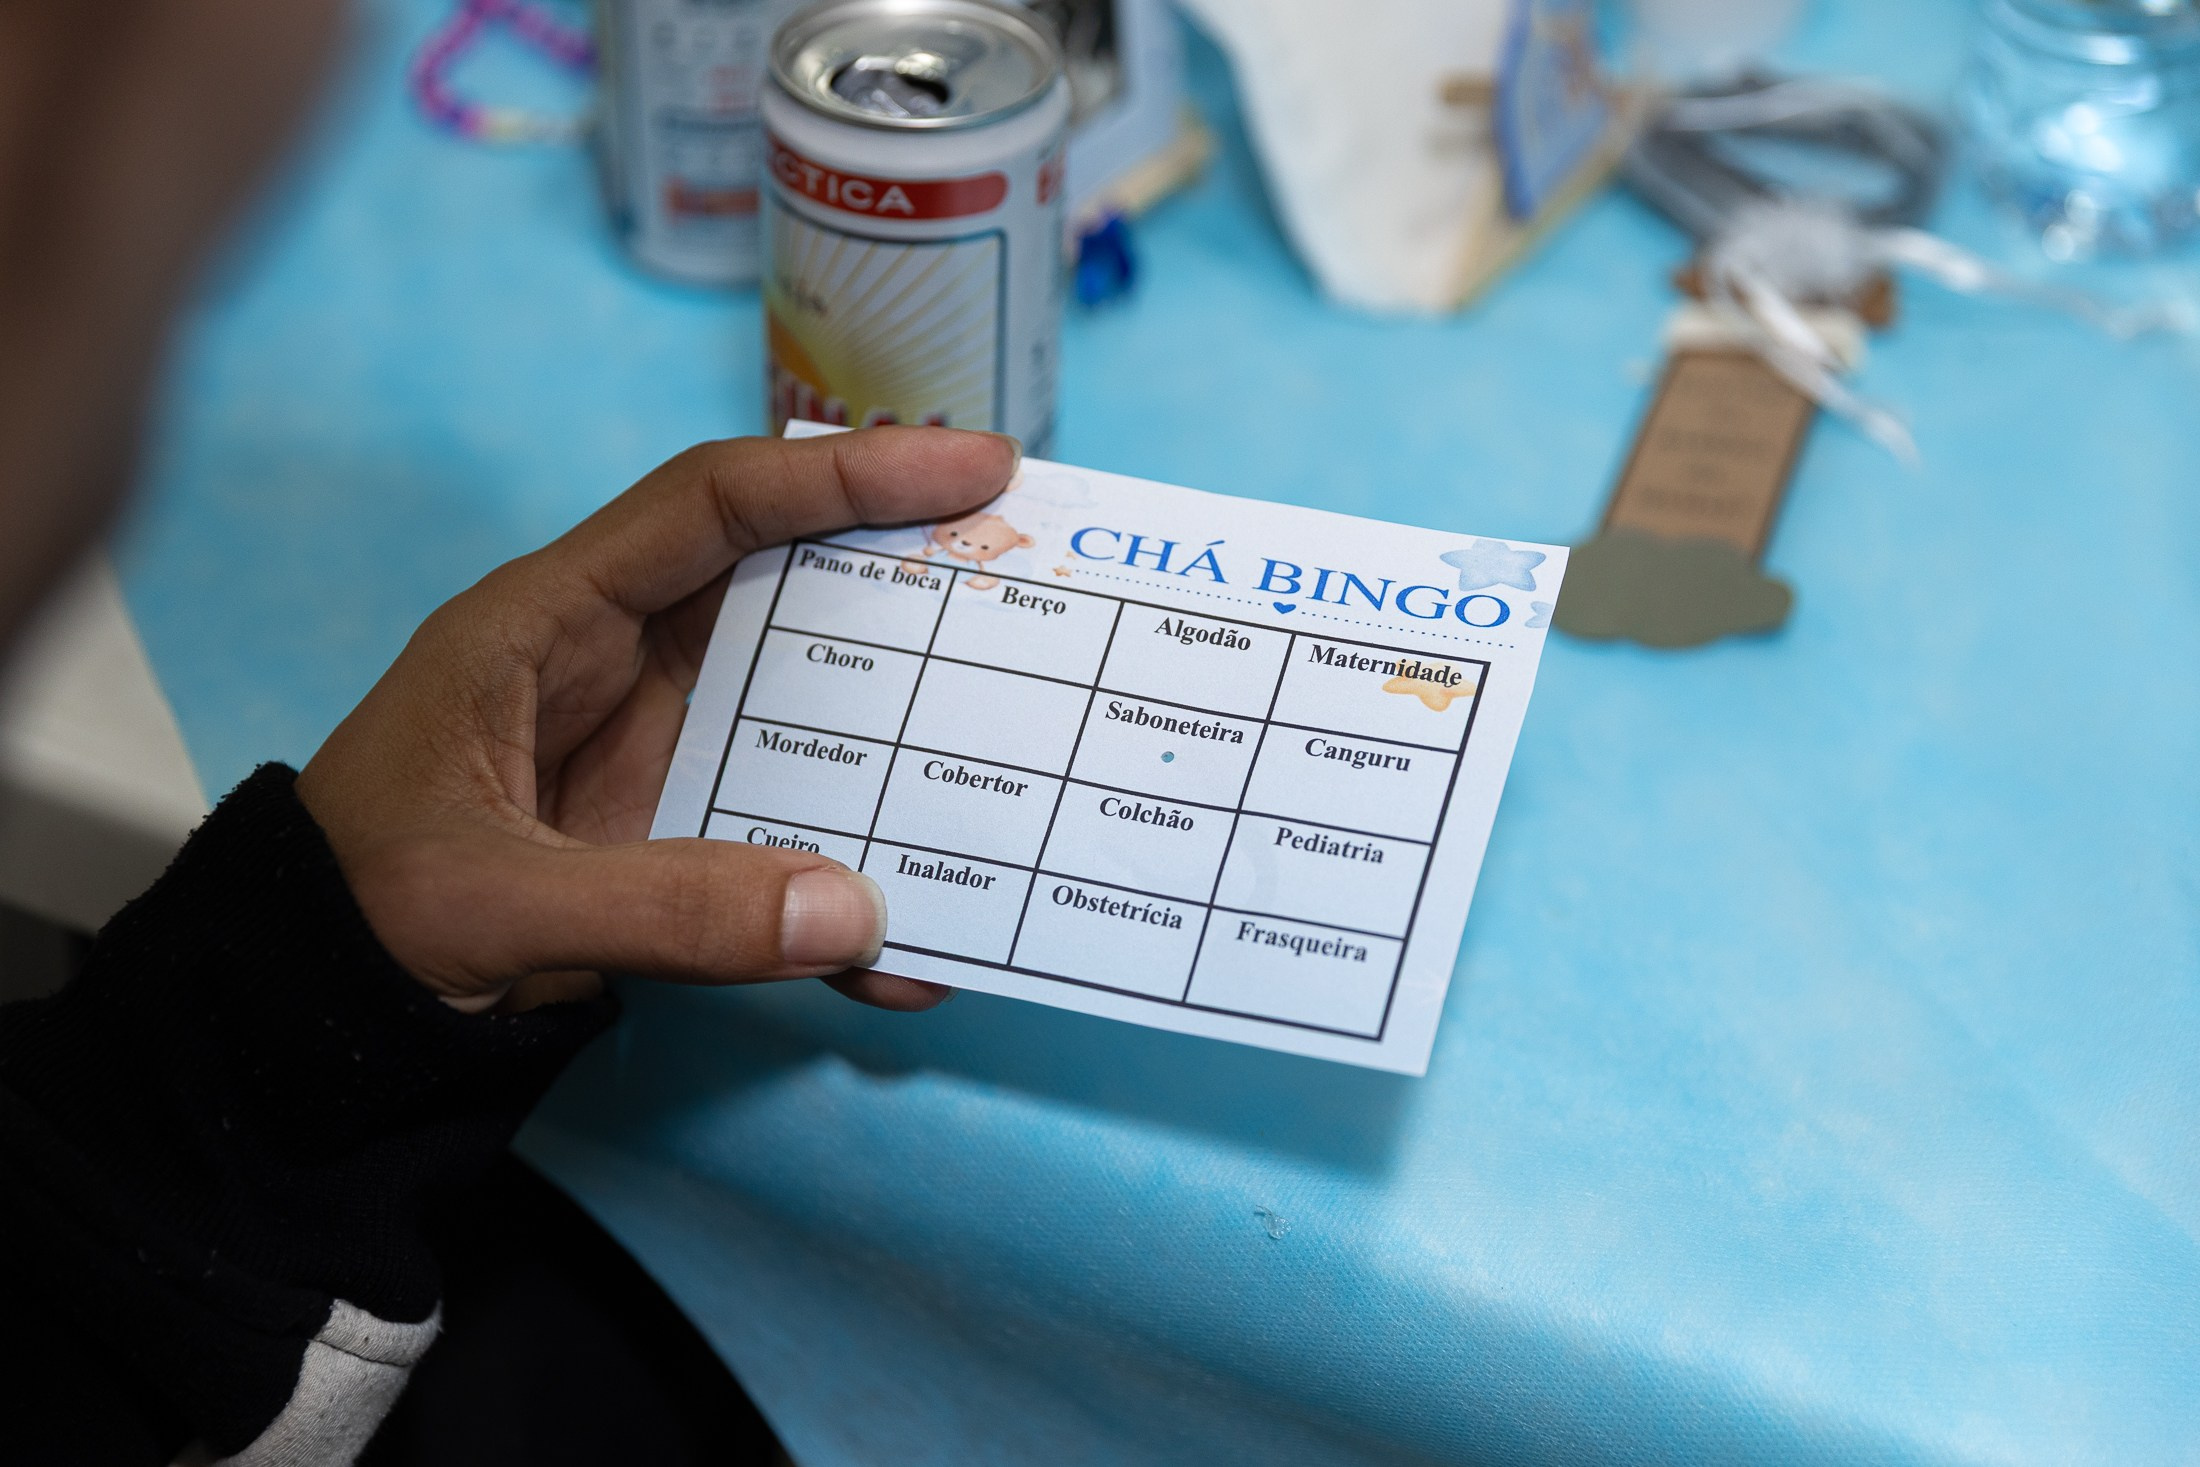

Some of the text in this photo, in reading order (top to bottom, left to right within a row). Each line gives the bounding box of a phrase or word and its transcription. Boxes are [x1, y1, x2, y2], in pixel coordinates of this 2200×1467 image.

[798, 548, 942, 592] Pano de boca
[1070, 526, 1512, 629] CHÁ BINGO
[1001, 586, 1066, 616] Berço
[1154, 617, 1251, 651] Algodão
[806, 643, 874, 671] Choro
[1308, 644, 1462, 688] Maternidade
[1105, 700, 1244, 744] Saboneteira
[755, 729, 868, 766] Mordedor
[1305, 738, 1411, 772] Canguru
[923, 760, 1029, 797] Cobertor
[1099, 797, 1194, 831] Colchão
[746, 827, 820, 854] Cueiro
[1275, 827, 1383, 863] Pediatria
[895, 853, 997, 890] Inalador
[1052, 885, 1182, 930] Obstetrícia
[1237, 921, 1366, 961] Frasqueira
